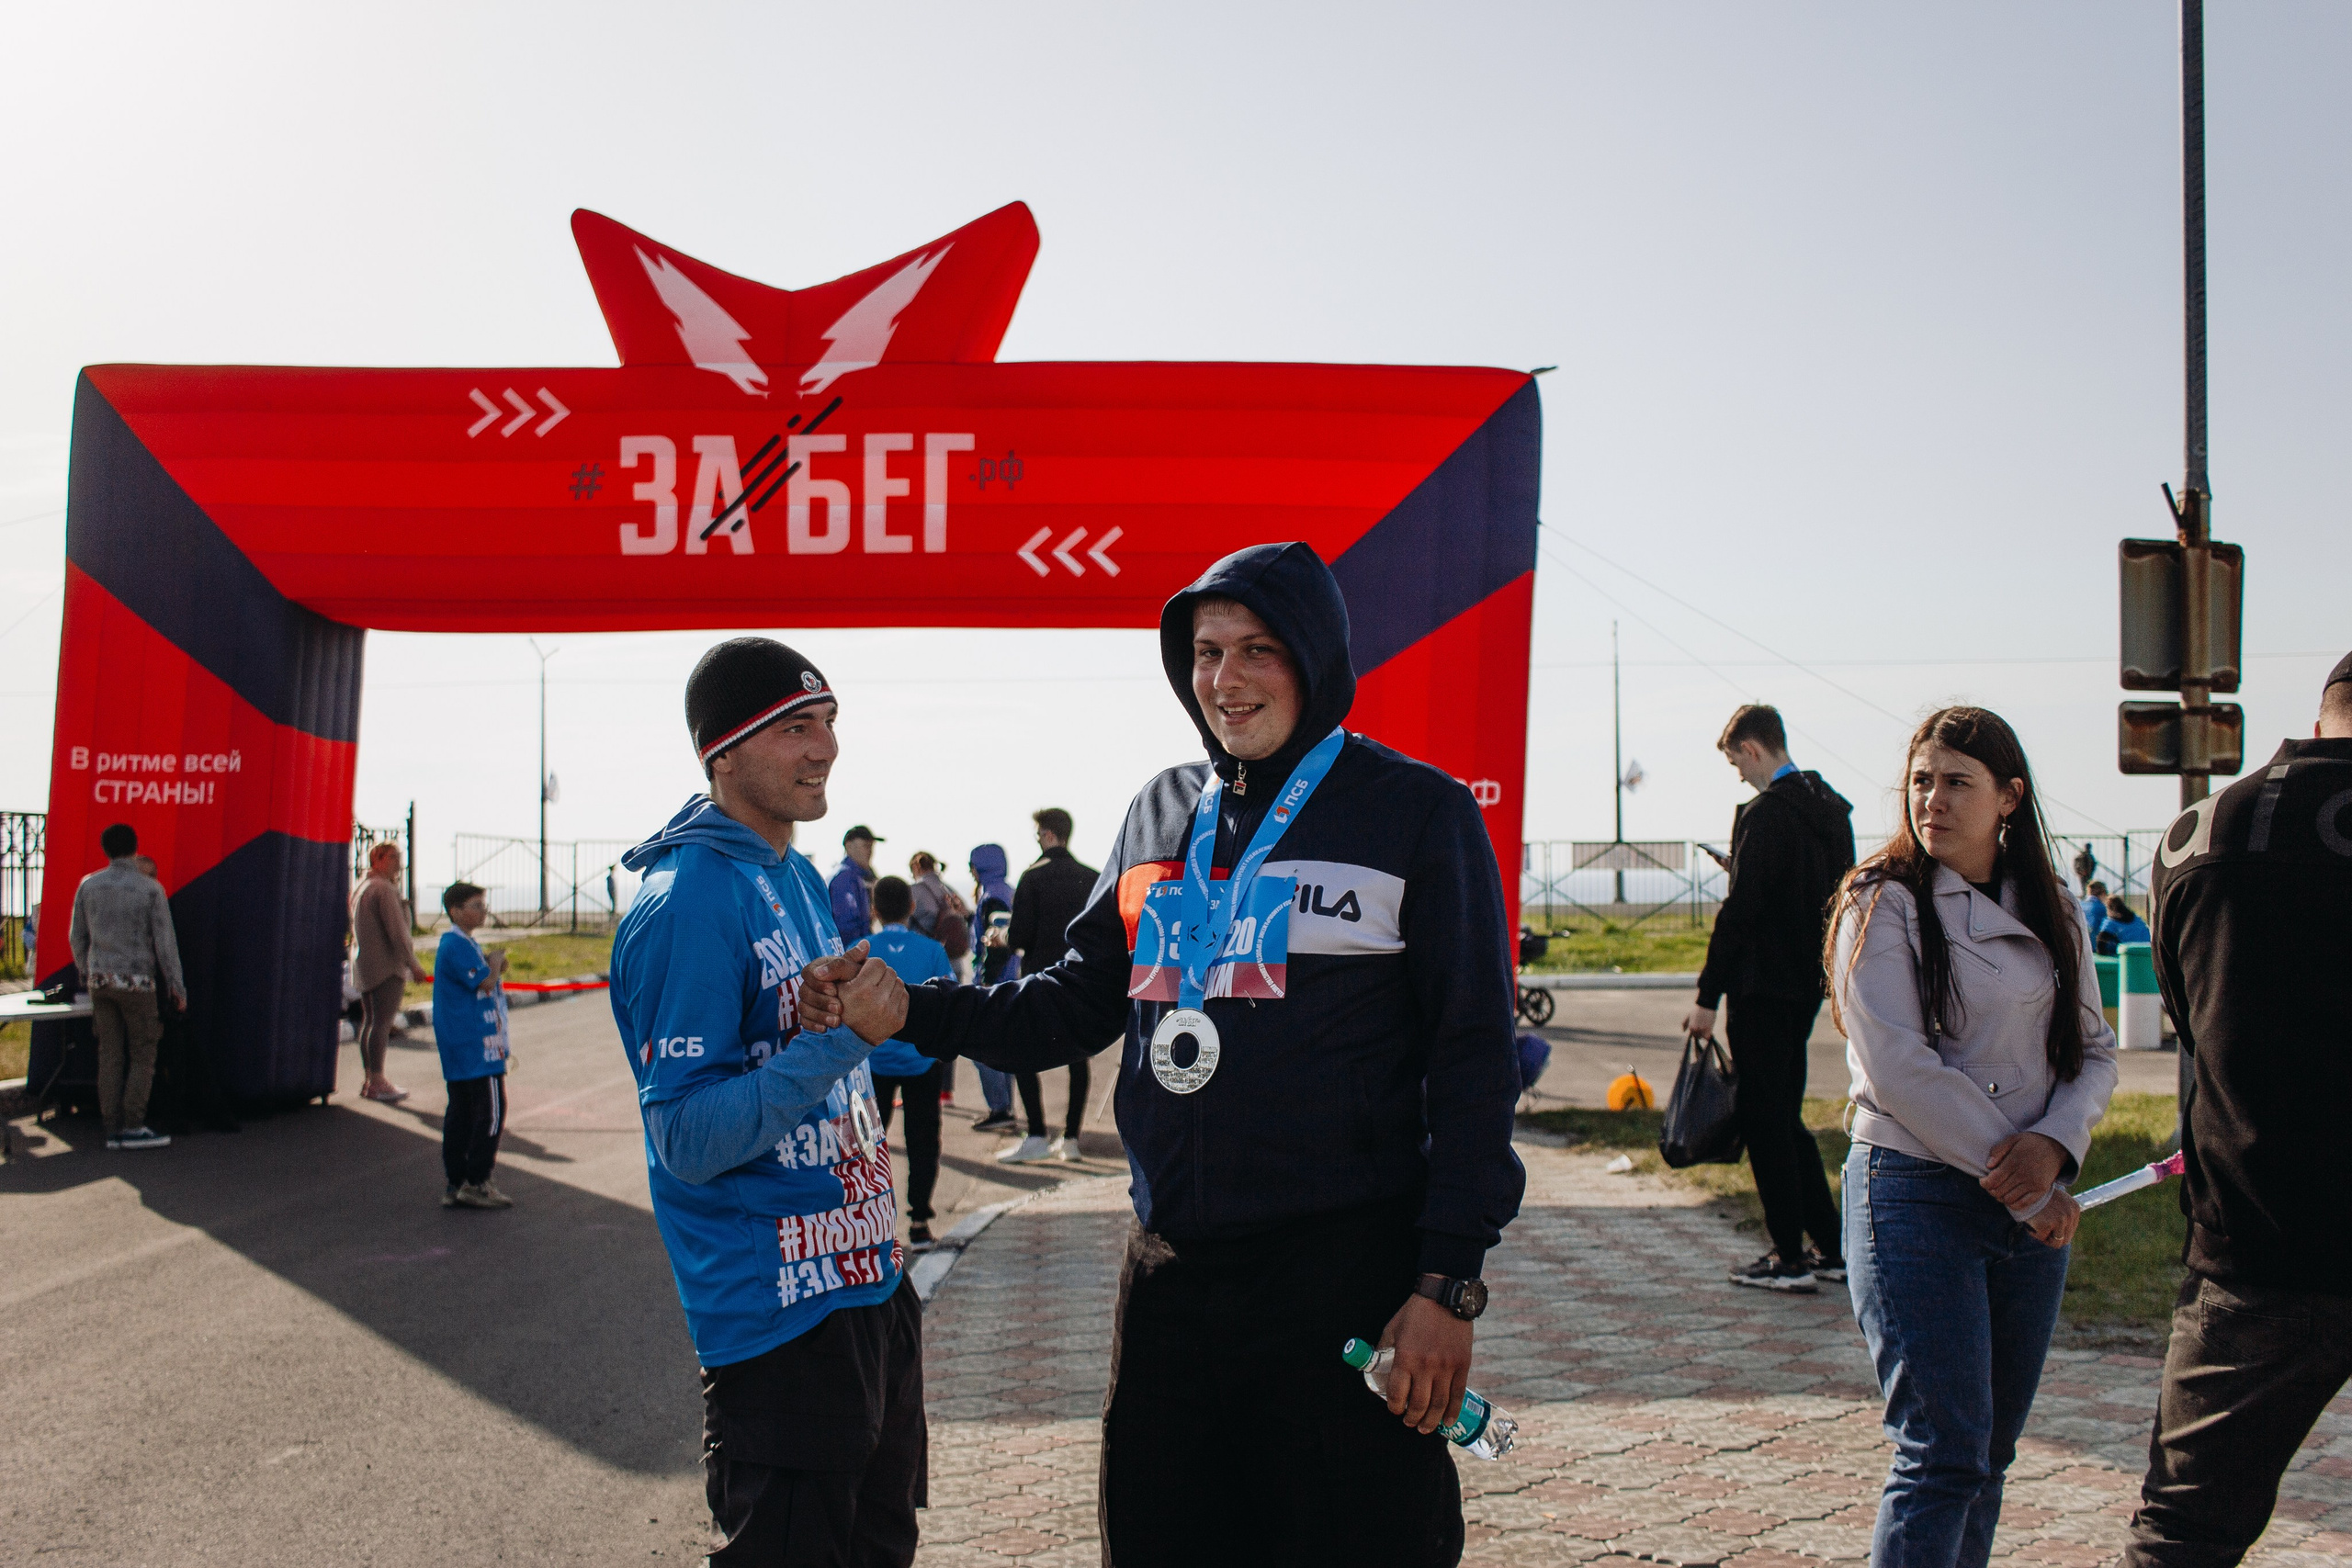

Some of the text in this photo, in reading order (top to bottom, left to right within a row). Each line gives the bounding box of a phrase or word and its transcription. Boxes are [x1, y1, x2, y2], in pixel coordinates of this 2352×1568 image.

[70, 745, 243, 774] В ритме всей
[94, 779, 215, 805] СТРАНЫ!
[1283, 778, 1309, 807] ПСБ
[1292, 884, 1362, 922] ILA
[658, 1036, 705, 1059] ПСБ
[777, 1248, 884, 1309] #ЗАБЕГ
